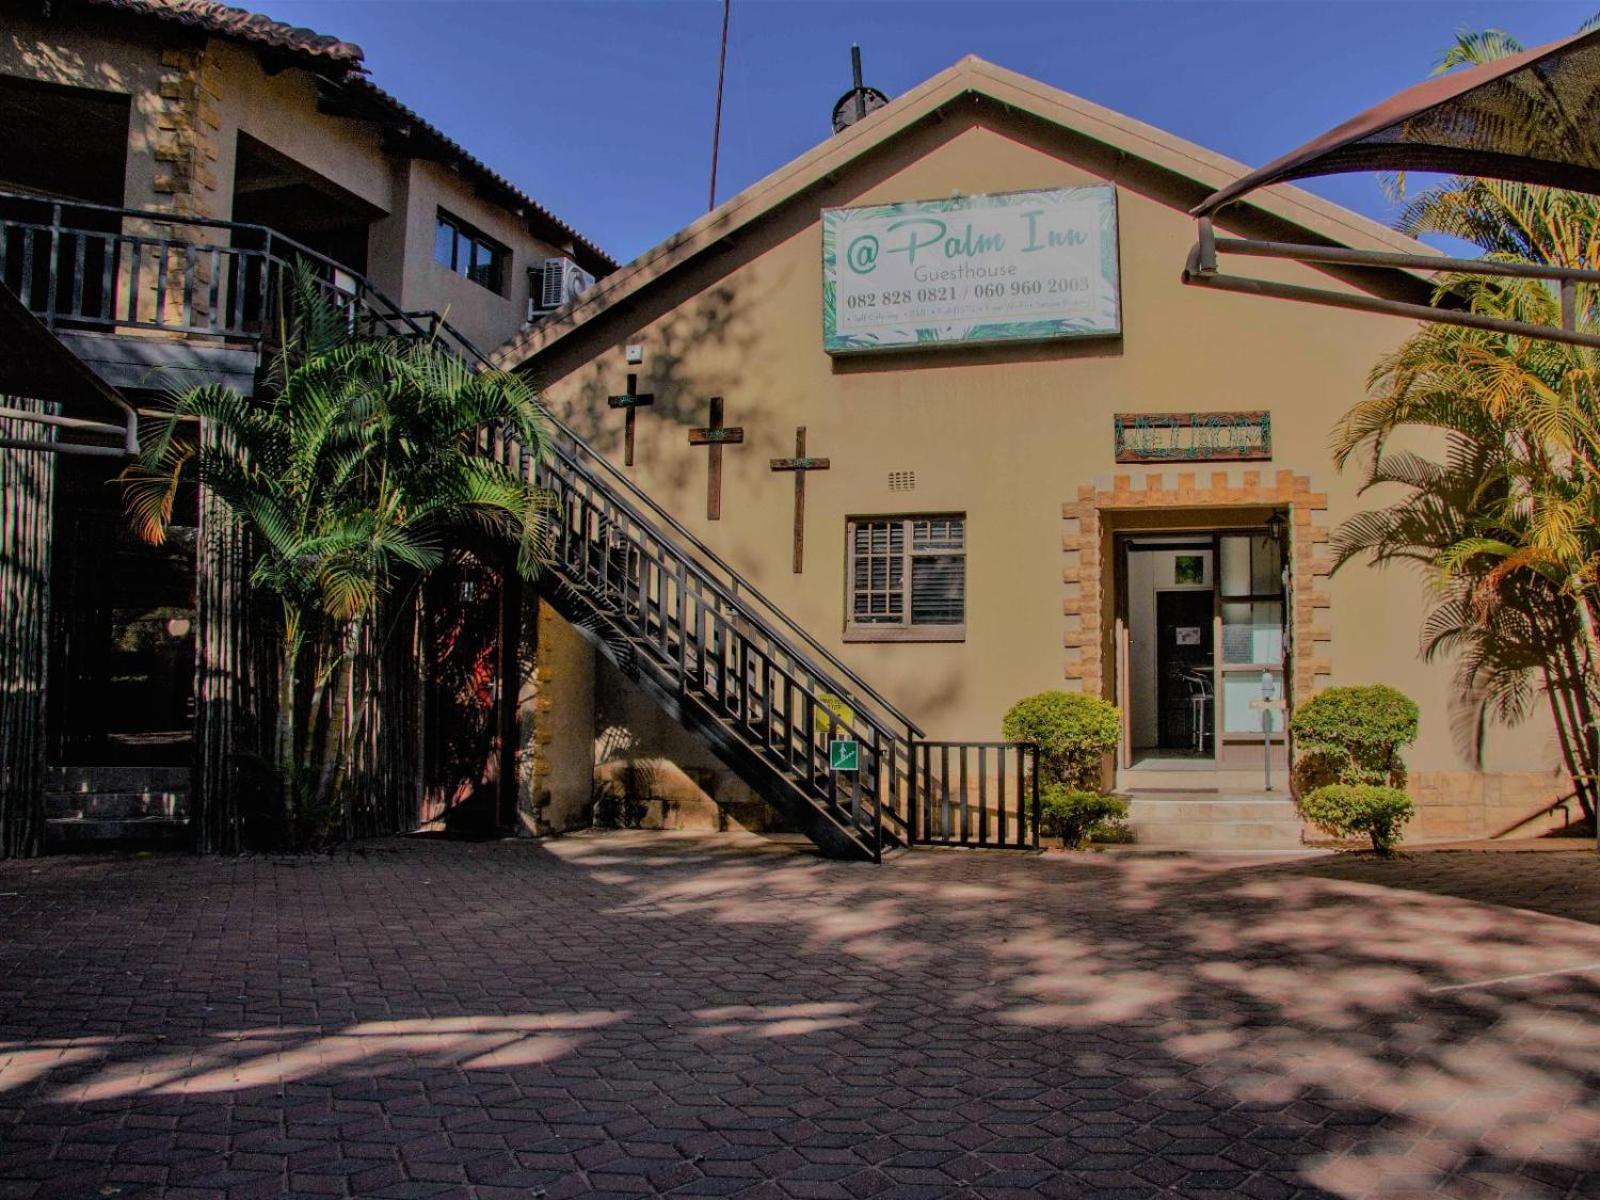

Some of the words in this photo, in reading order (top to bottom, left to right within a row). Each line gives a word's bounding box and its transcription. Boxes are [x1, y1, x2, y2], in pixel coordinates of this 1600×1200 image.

[847, 234, 880, 275] @
[886, 216, 1006, 265] Palm
[1020, 209, 1089, 253] Inn
[913, 261, 1018, 284] Guesthouse
[847, 293, 876, 309] 082
[882, 289, 912, 305] 828
[917, 286, 957, 303] 0821
[974, 281, 1006, 299] 060
[1011, 278, 1042, 297] 960
